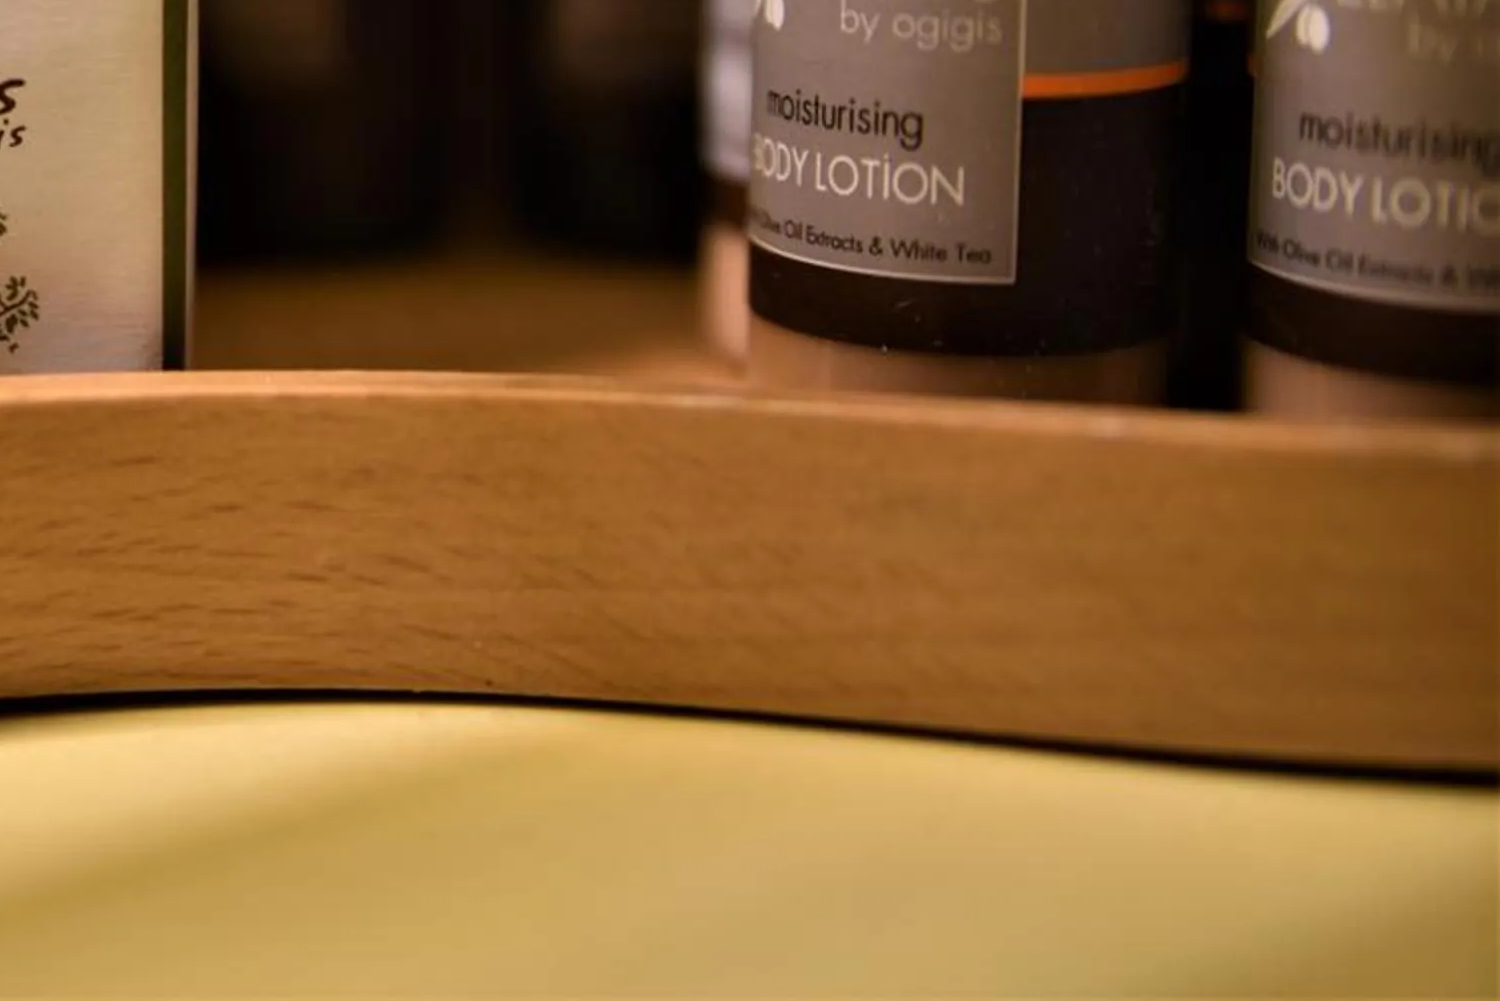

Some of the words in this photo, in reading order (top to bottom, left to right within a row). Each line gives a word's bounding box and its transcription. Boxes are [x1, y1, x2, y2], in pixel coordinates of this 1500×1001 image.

[892, 11, 1002, 53] ogigis
[766, 87, 924, 151] moisturising
[1272, 156, 1364, 218] BODY
[784, 220, 803, 240] Oil
[805, 225, 863, 254] Extracts
[868, 236, 884, 256] &
[890, 238, 948, 262] White
[956, 242, 992, 264] Tea
